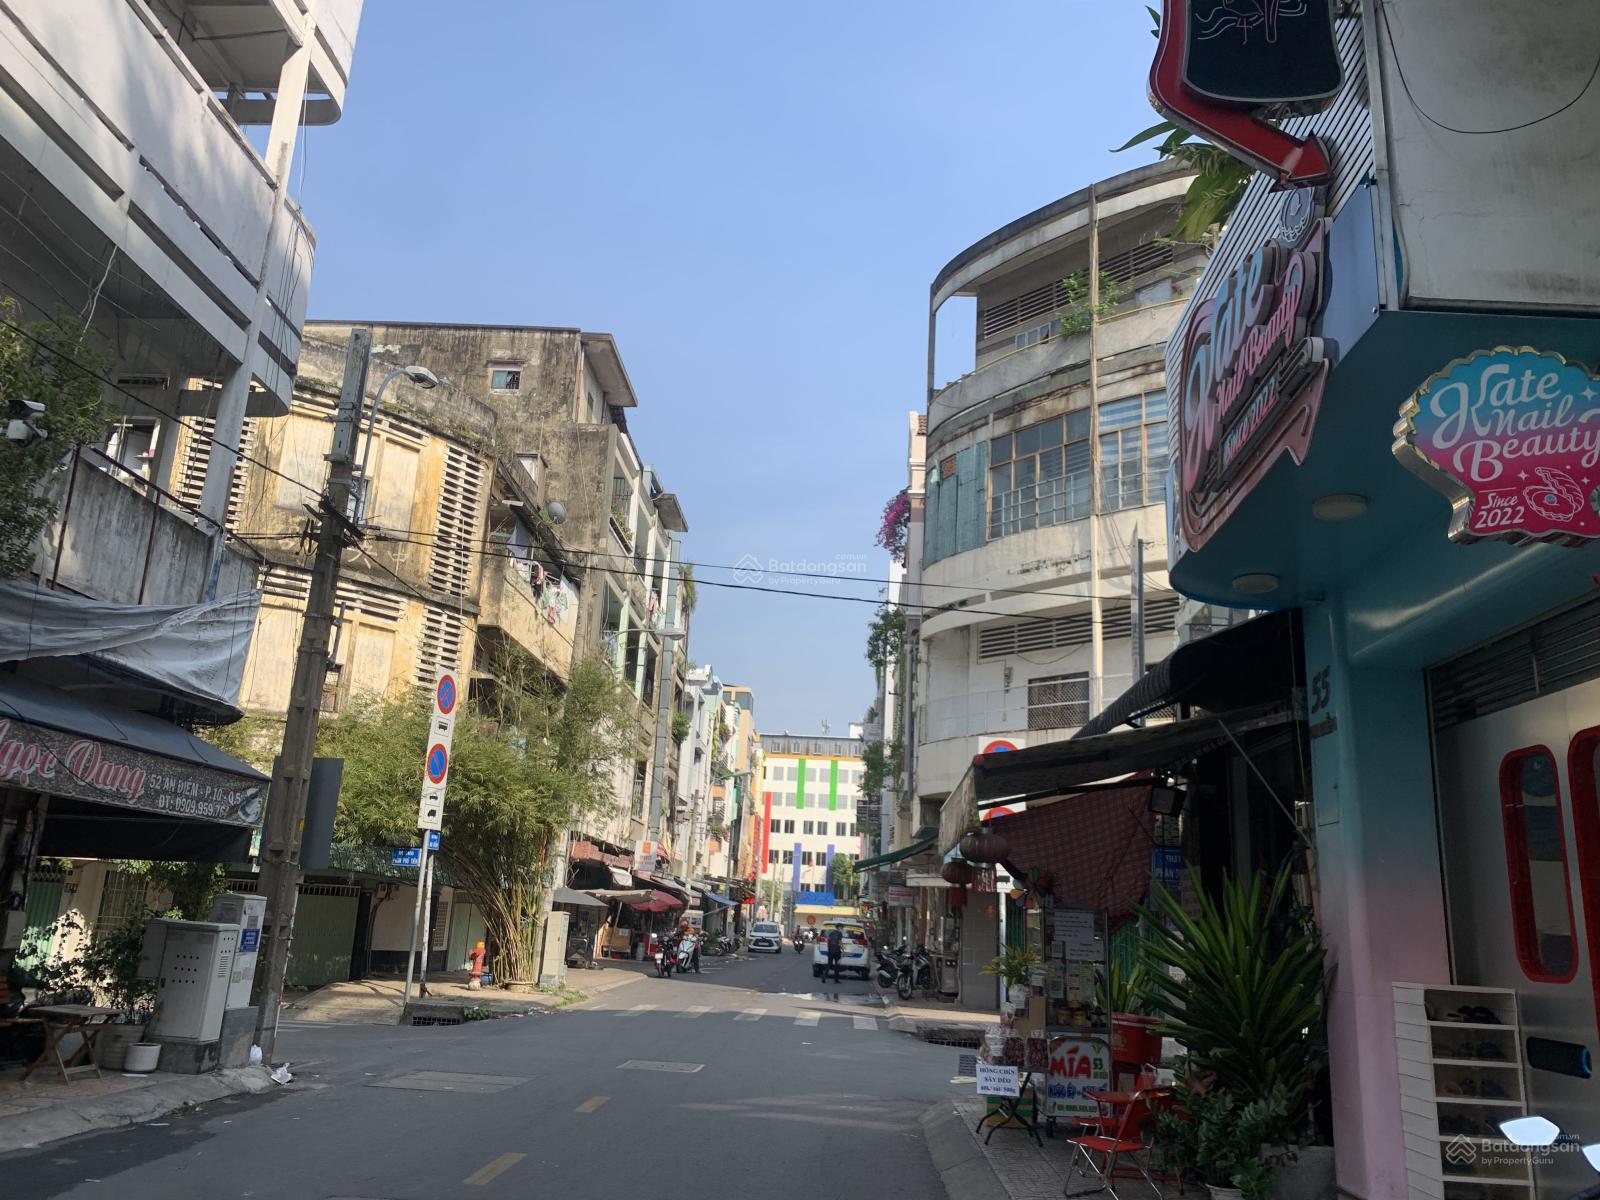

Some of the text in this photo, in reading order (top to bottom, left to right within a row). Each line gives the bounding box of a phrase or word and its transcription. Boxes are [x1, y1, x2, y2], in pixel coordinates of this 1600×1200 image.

[1185, 246, 1276, 491] Kate
[1250, 376, 1277, 433] 2022
[1430, 363, 1562, 450] Kate
[1452, 426, 1600, 483] Beauty
[1475, 506, 1525, 529] 2022
[1481, 492, 1520, 510] Since
[1311, 664, 1331, 714] 55
[0, 718, 58, 787] gọc
[149, 774, 162, 790] 52
[163, 777, 176, 793] AN
[204, 785, 223, 802] P.10
[228, 790, 242, 806] Q.5
[1049, 1045, 1092, 1078] MÍA
